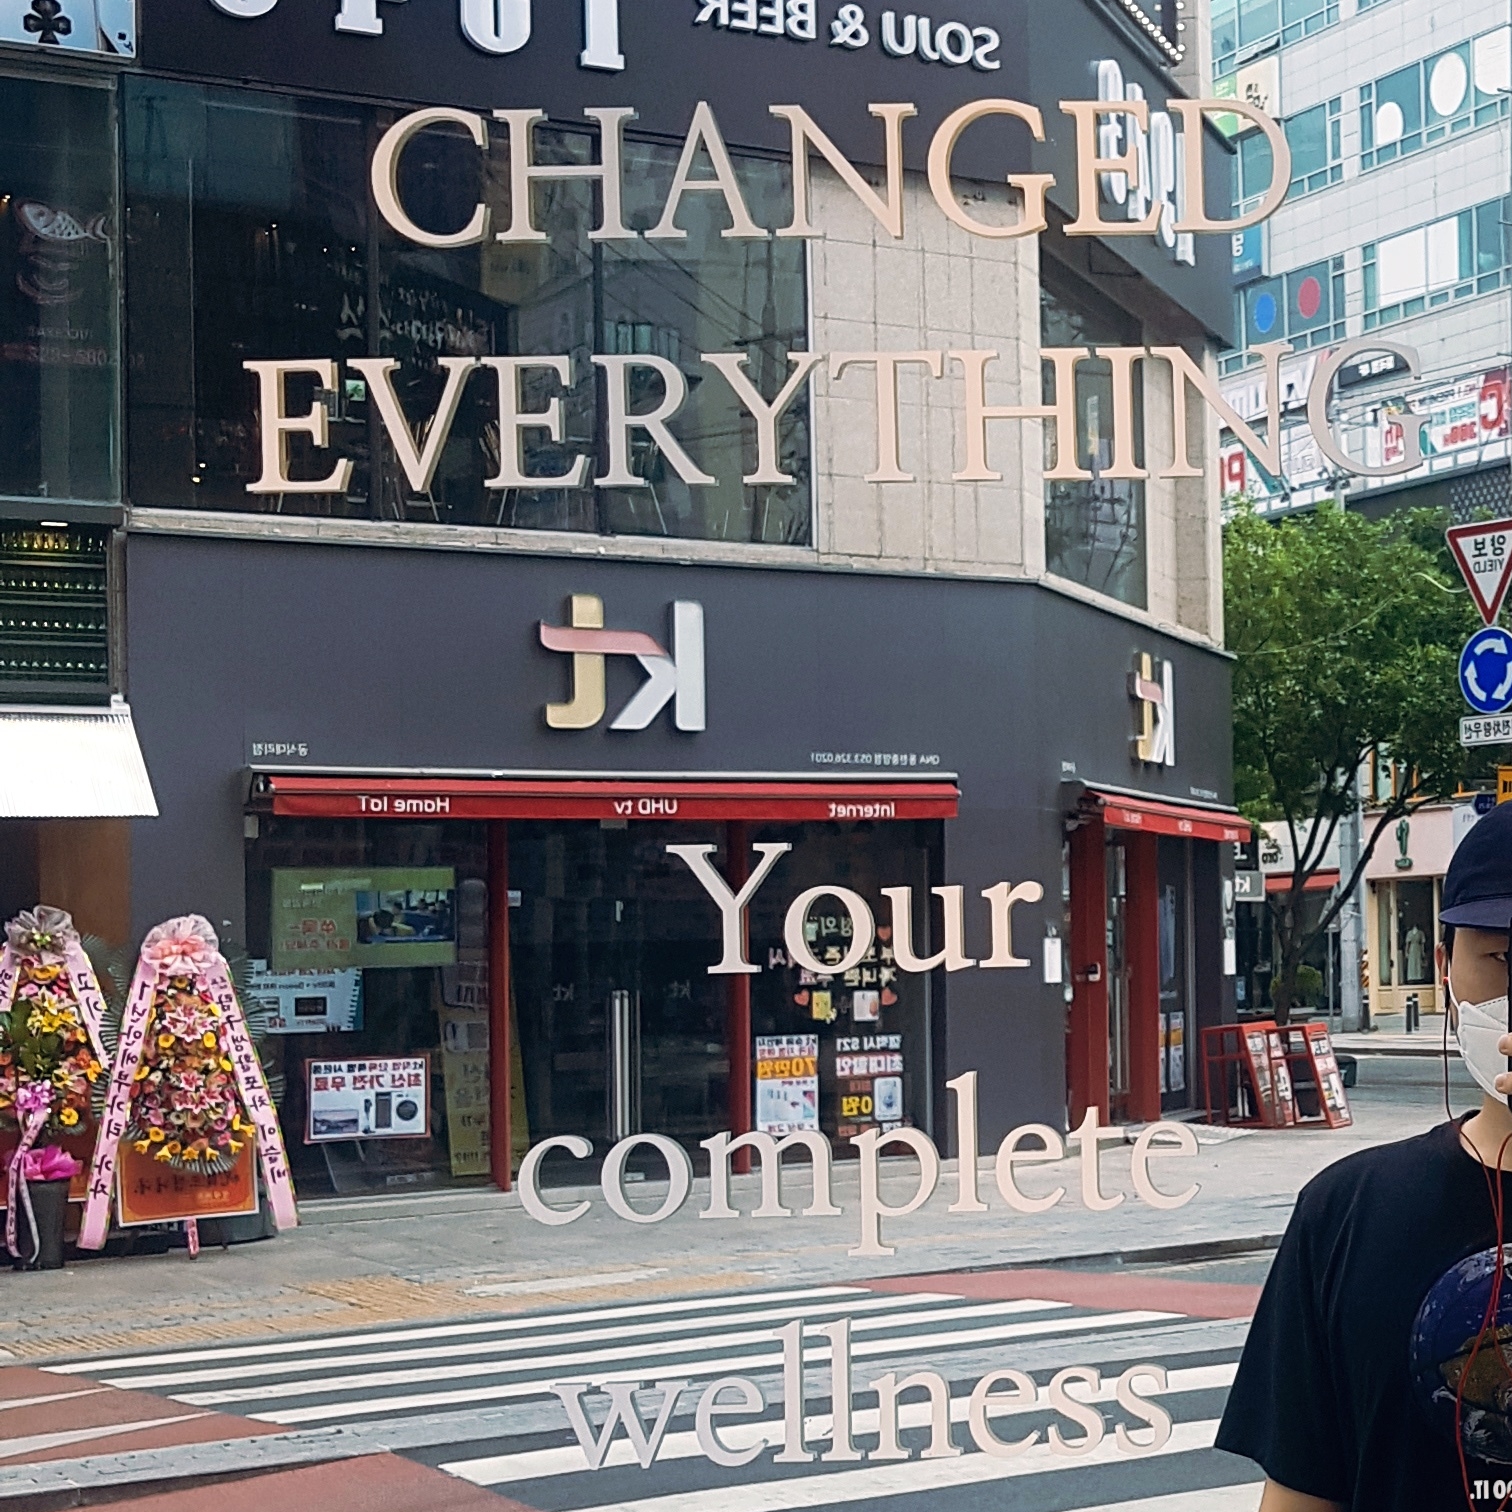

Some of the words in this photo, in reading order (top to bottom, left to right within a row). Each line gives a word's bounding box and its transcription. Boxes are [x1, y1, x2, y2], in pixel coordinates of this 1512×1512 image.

[370, 99, 1293, 248] CHANGED
[243, 340, 1431, 497] EVERYTHING
[666, 842, 1044, 974] Your
[517, 1071, 1201, 1256] complete
[549, 1317, 1174, 1471] wellness
